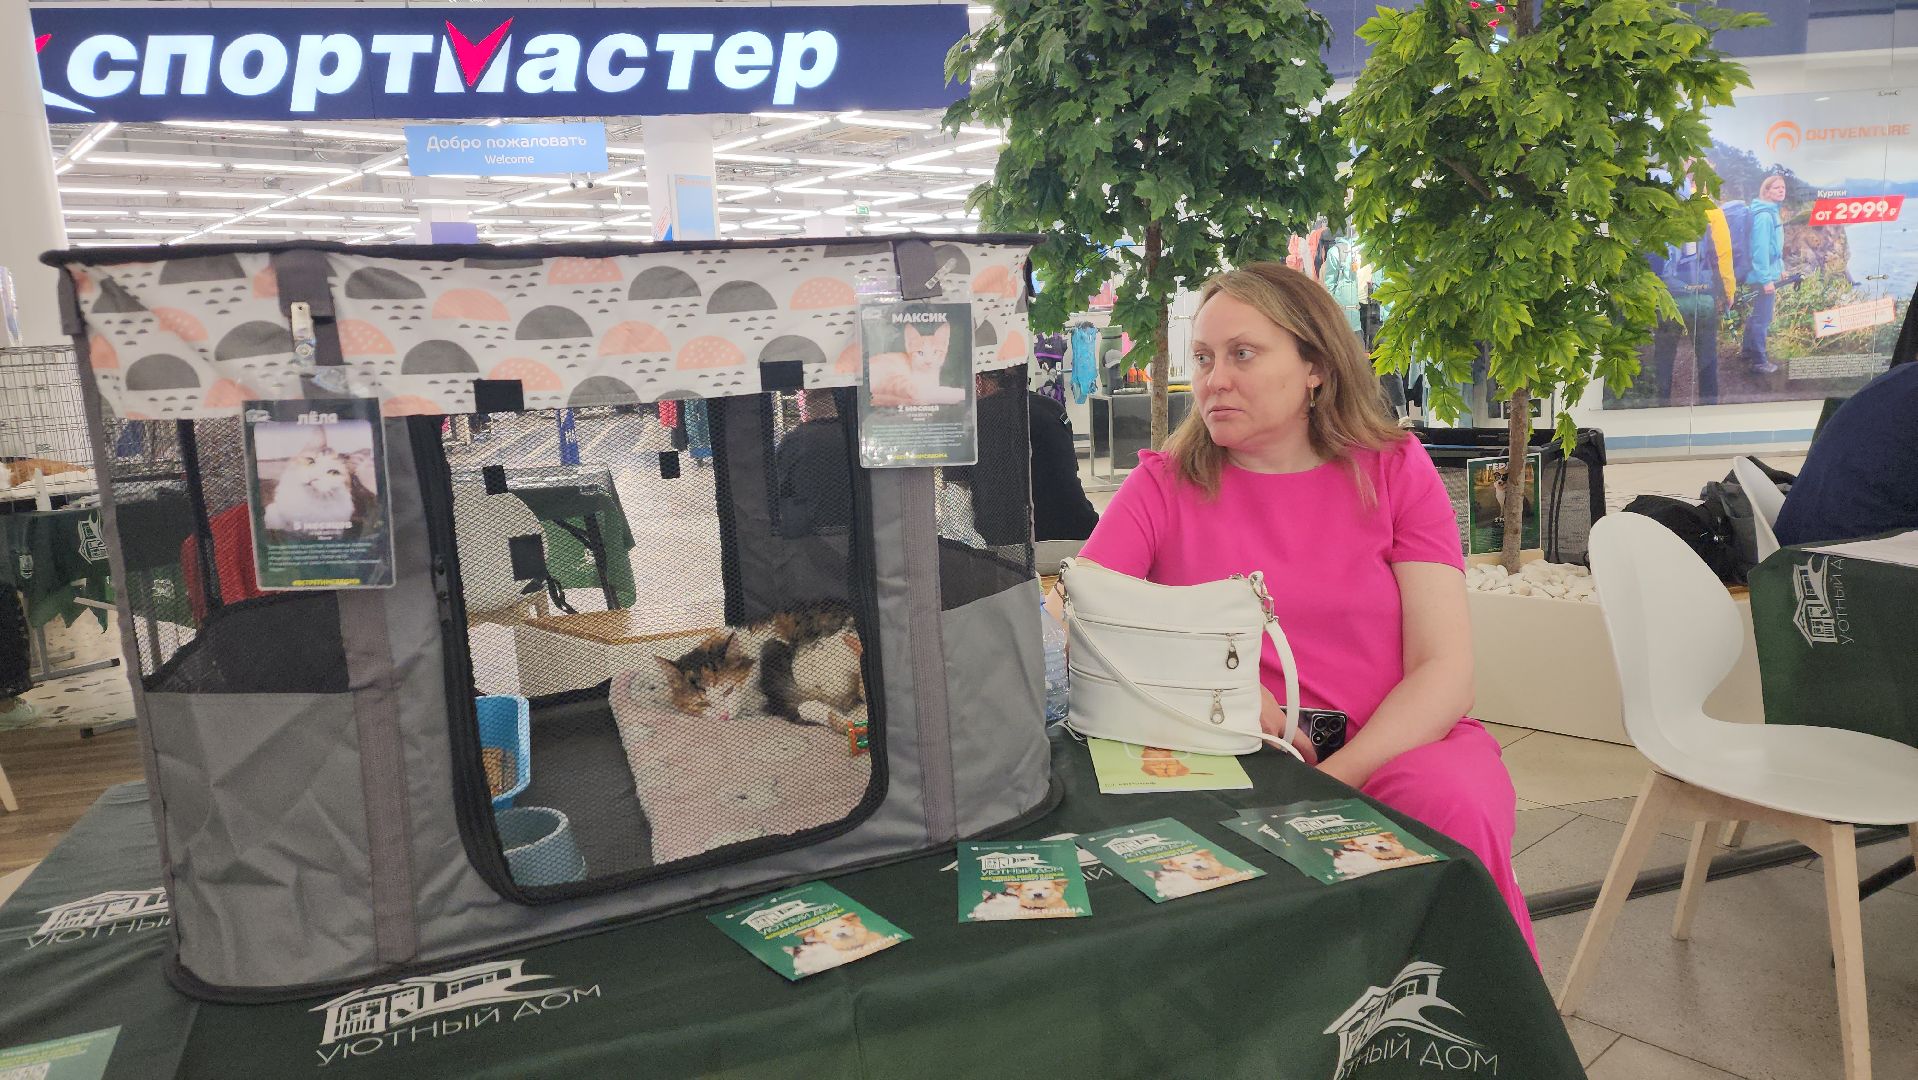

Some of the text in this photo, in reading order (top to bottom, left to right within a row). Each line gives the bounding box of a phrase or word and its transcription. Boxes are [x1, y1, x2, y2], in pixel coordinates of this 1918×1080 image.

[1806, 123, 1912, 142] OUTVENTURE
[427, 135, 587, 152] Добро пожаловать
[485, 154, 535, 165] Welcome
[1817, 190, 1848, 199] Куртки
[892, 312, 948, 323] МАКСИК
[1485, 462, 1509, 471] ГЕР
[24, 915, 172, 950] УЮТНЫ
[315, 984, 601, 1067] УЮТНЫЙ ДОМ
[1419, 1040, 1498, 1076] ДОМ
